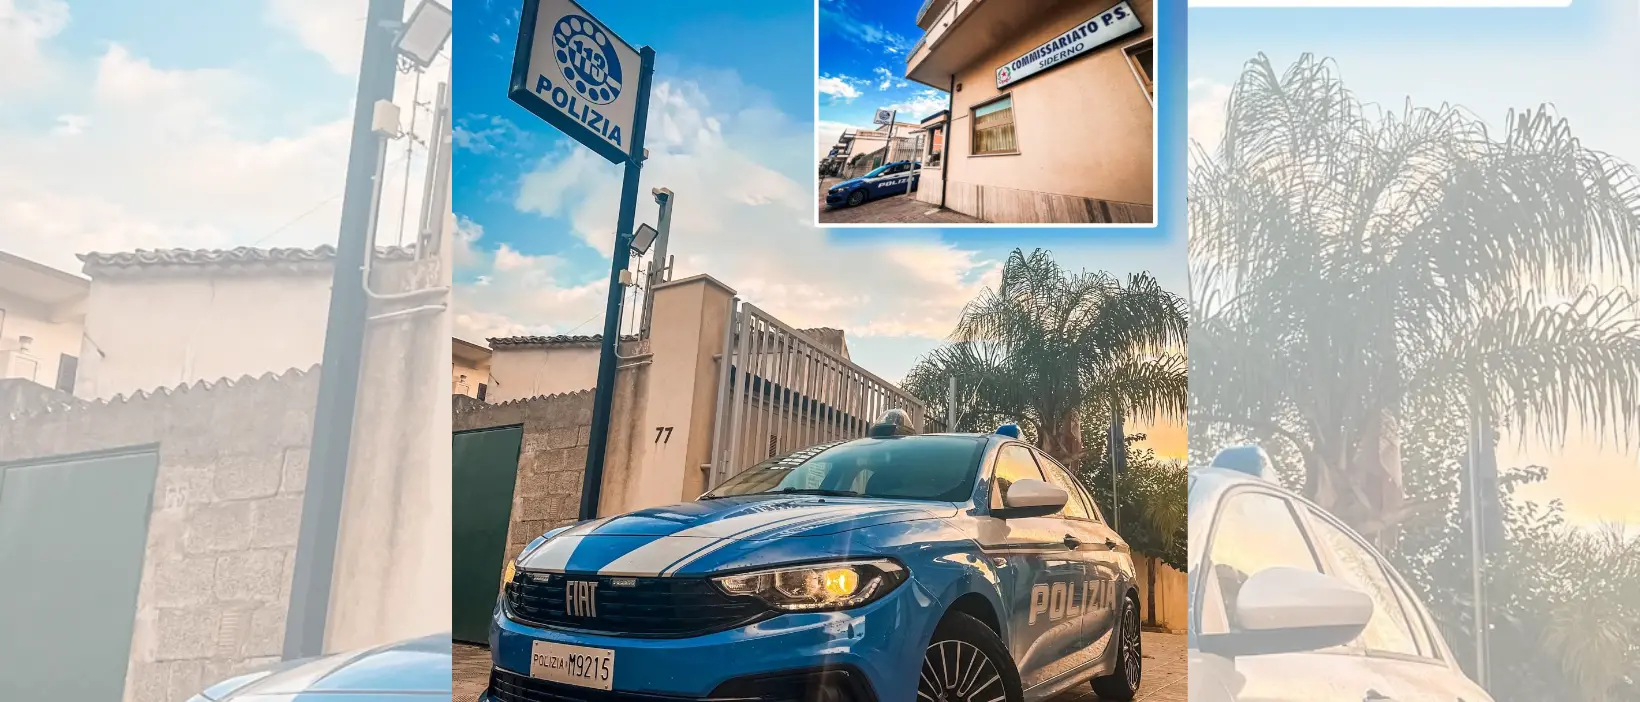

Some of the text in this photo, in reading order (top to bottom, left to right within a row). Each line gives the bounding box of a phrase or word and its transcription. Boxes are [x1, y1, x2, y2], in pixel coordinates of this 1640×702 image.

[1011, 6, 1130, 71] COMMISSARIATO P.S.
[1039, 43, 1084, 69] SIDERNO
[573, 40, 605, 83] 113
[535, 74, 622, 147] POLIZIA
[878, 177, 915, 188] POLIZ
[655, 426, 674, 444] 77
[566, 580, 598, 618] FIAT
[1028, 579, 1116, 626] POLIZIA
[533, 653, 610, 681] POLIZIA M9215
